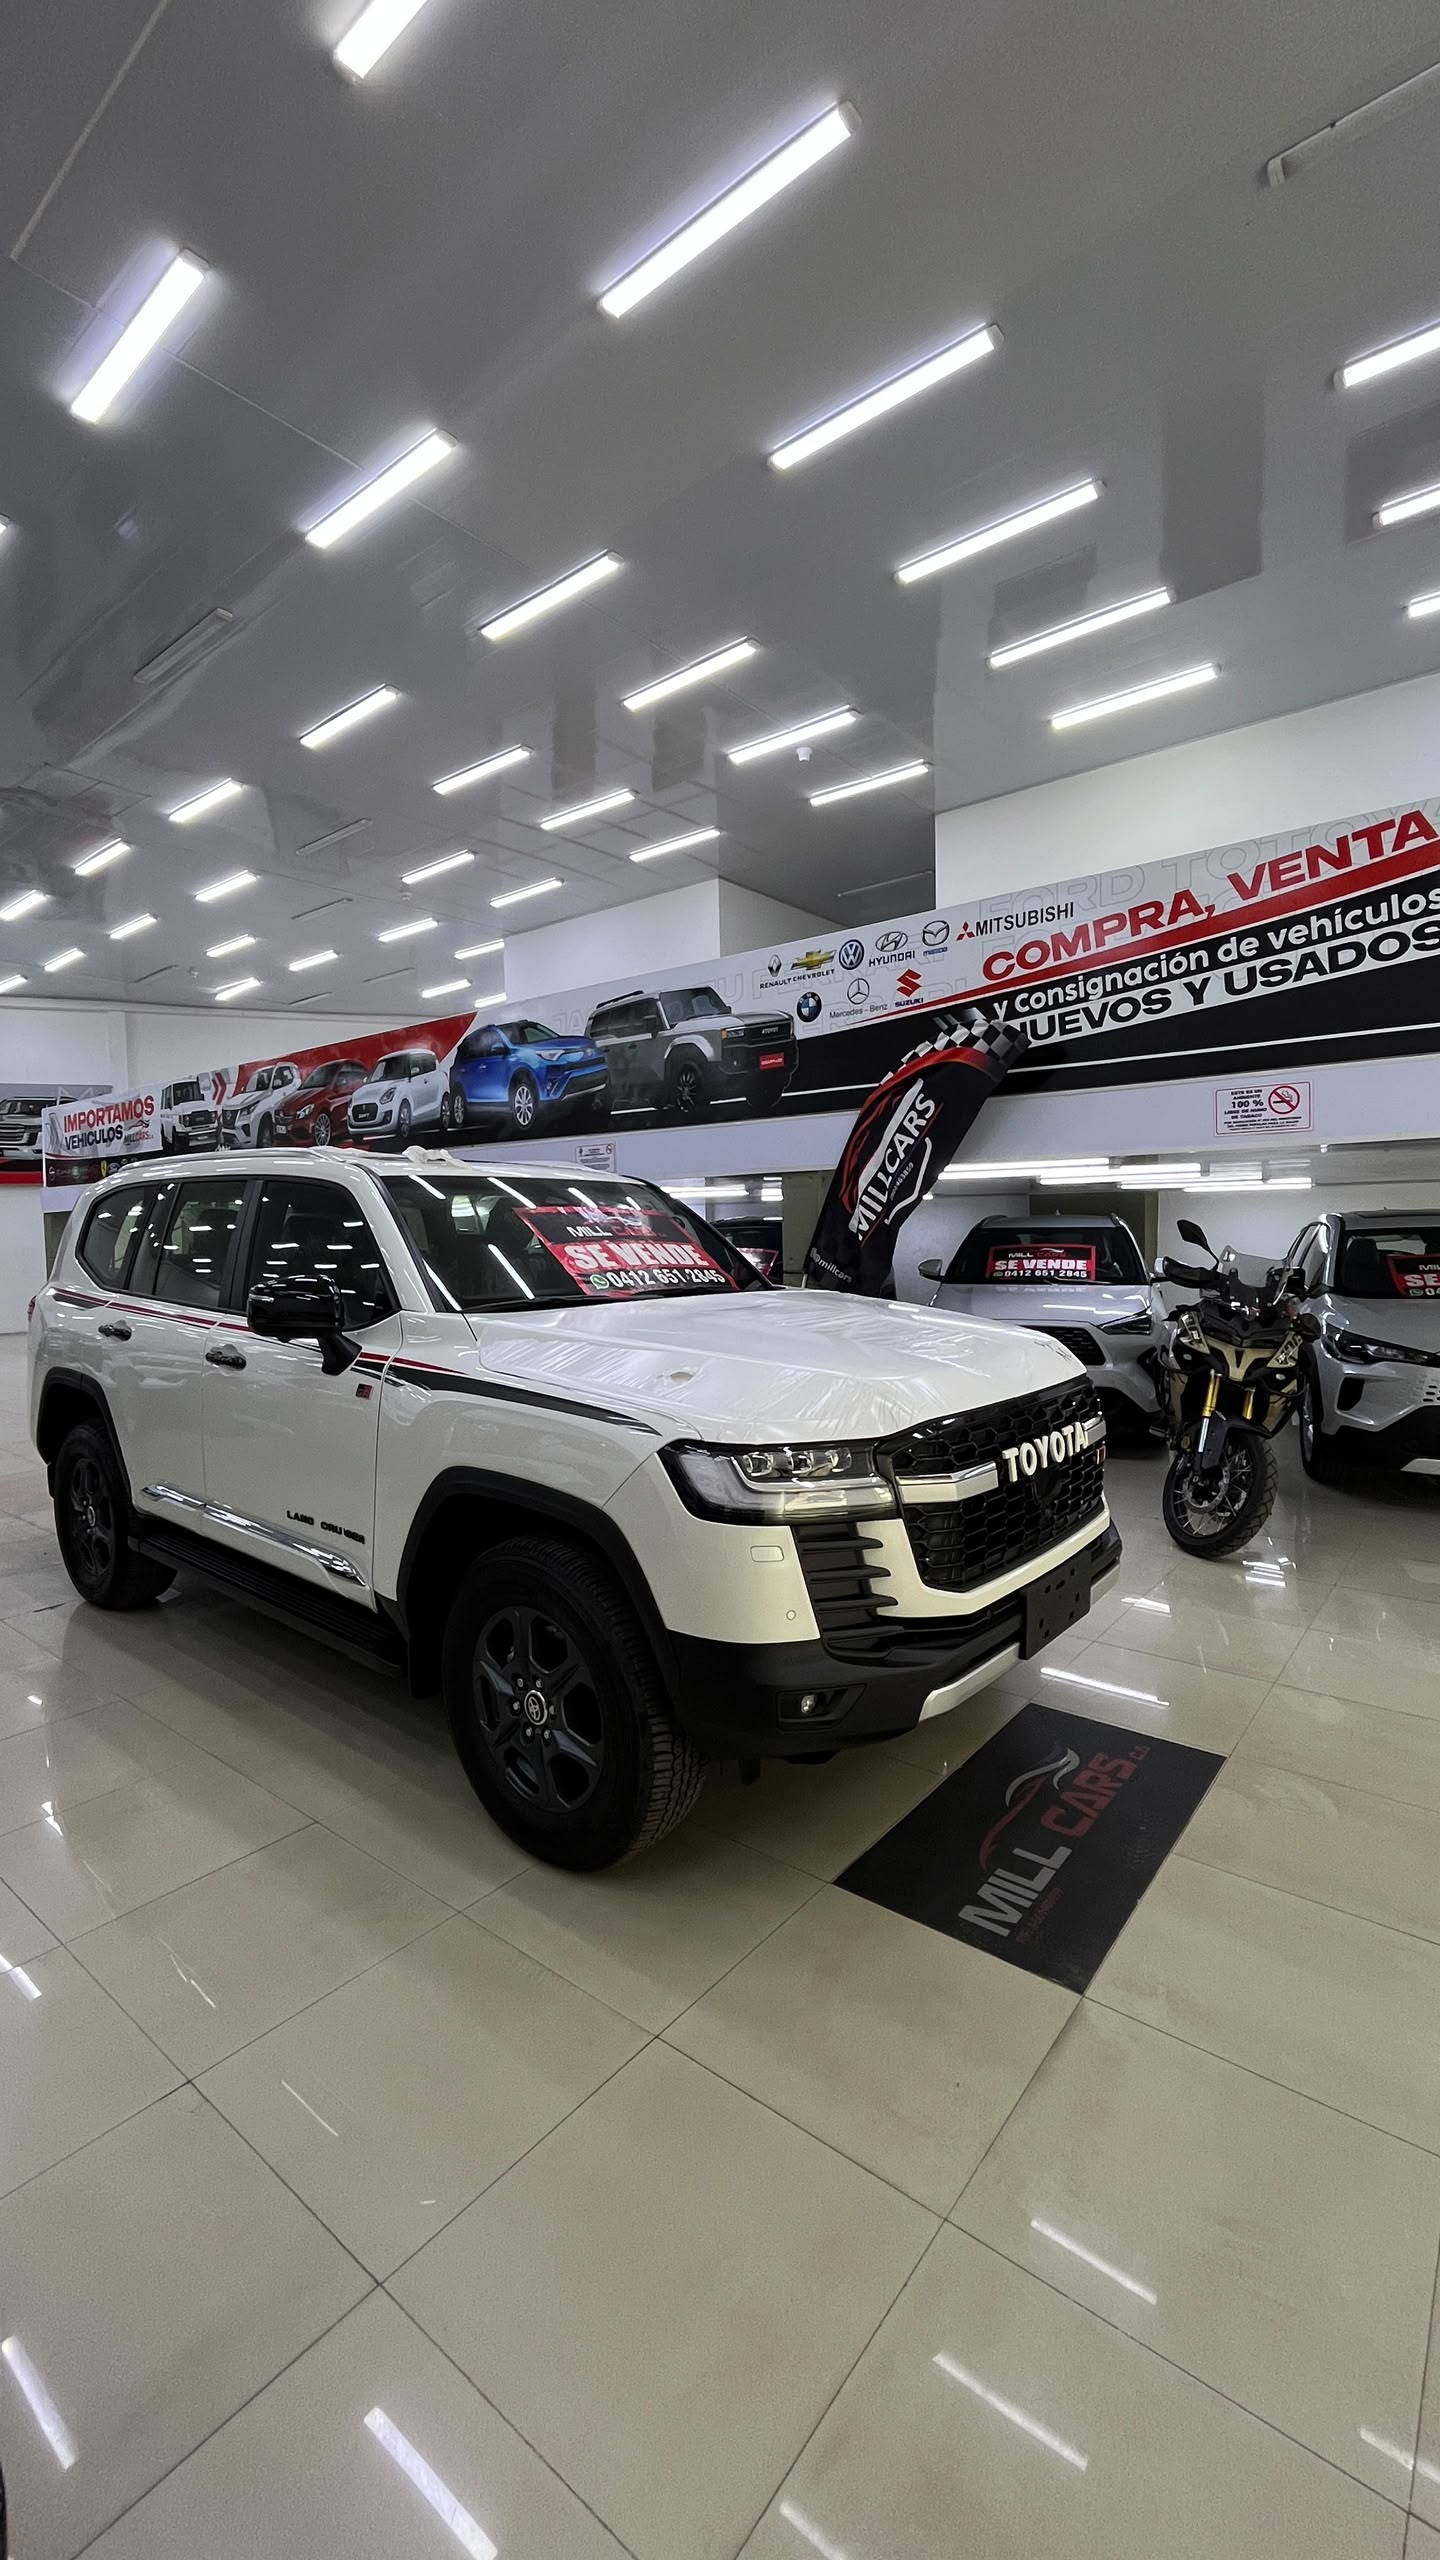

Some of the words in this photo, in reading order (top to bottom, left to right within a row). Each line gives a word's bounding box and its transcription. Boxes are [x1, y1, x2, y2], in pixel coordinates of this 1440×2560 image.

[982, 889, 1216, 981] COMPRA,
[1227, 810, 1439, 901] VENTA
[975, 901, 1074, 937] MITSUBISHI
[868, 950, 916, 968] HYUNDAI
[993, 1000, 1009, 1022] y
[1015, 949, 1210, 1013] consignación
[1217, 936, 1260, 963] de
[1267, 888, 1440, 950] vehículos
[1183, 977, 1212, 1006] Y
[1224, 920, 1440, 996] USADOS
[759, 977, 792, 990] RENAULT
[793, 968, 835, 982] CHEVROLET
[894, 997, 924, 1008] SUZUKI
[1231, 1100, 1250, 1109] 100
[1252, 1099, 1264, 1108] %
[63, 1095, 155, 1133] IMPORTAMOS
[64, 1124, 123, 1151] VEHICULOS
[566, 1226, 613, 1238] MILL
[564, 1243, 619, 1270] SE
[608, 1242, 710, 1267] VENDE
[994, 1260, 1018, 1271] SE
[1022, 1259, 1088, 1270] VENDE
[607, 1270, 655, 1288] 0412
[652, 1269, 687, 1285] 651
[1004, 1269, 1032, 1278] 0412
[1034, 1269, 1055, 1278] 651
[1058, 1270, 1088, 1279] 2845
[1404, 1273, 1440, 1287] SE
[1001, 1421, 1090, 1483] TOYOTA
[957, 1845, 1073, 1937] MILL
[1040, 1752, 1138, 1839] CARS
